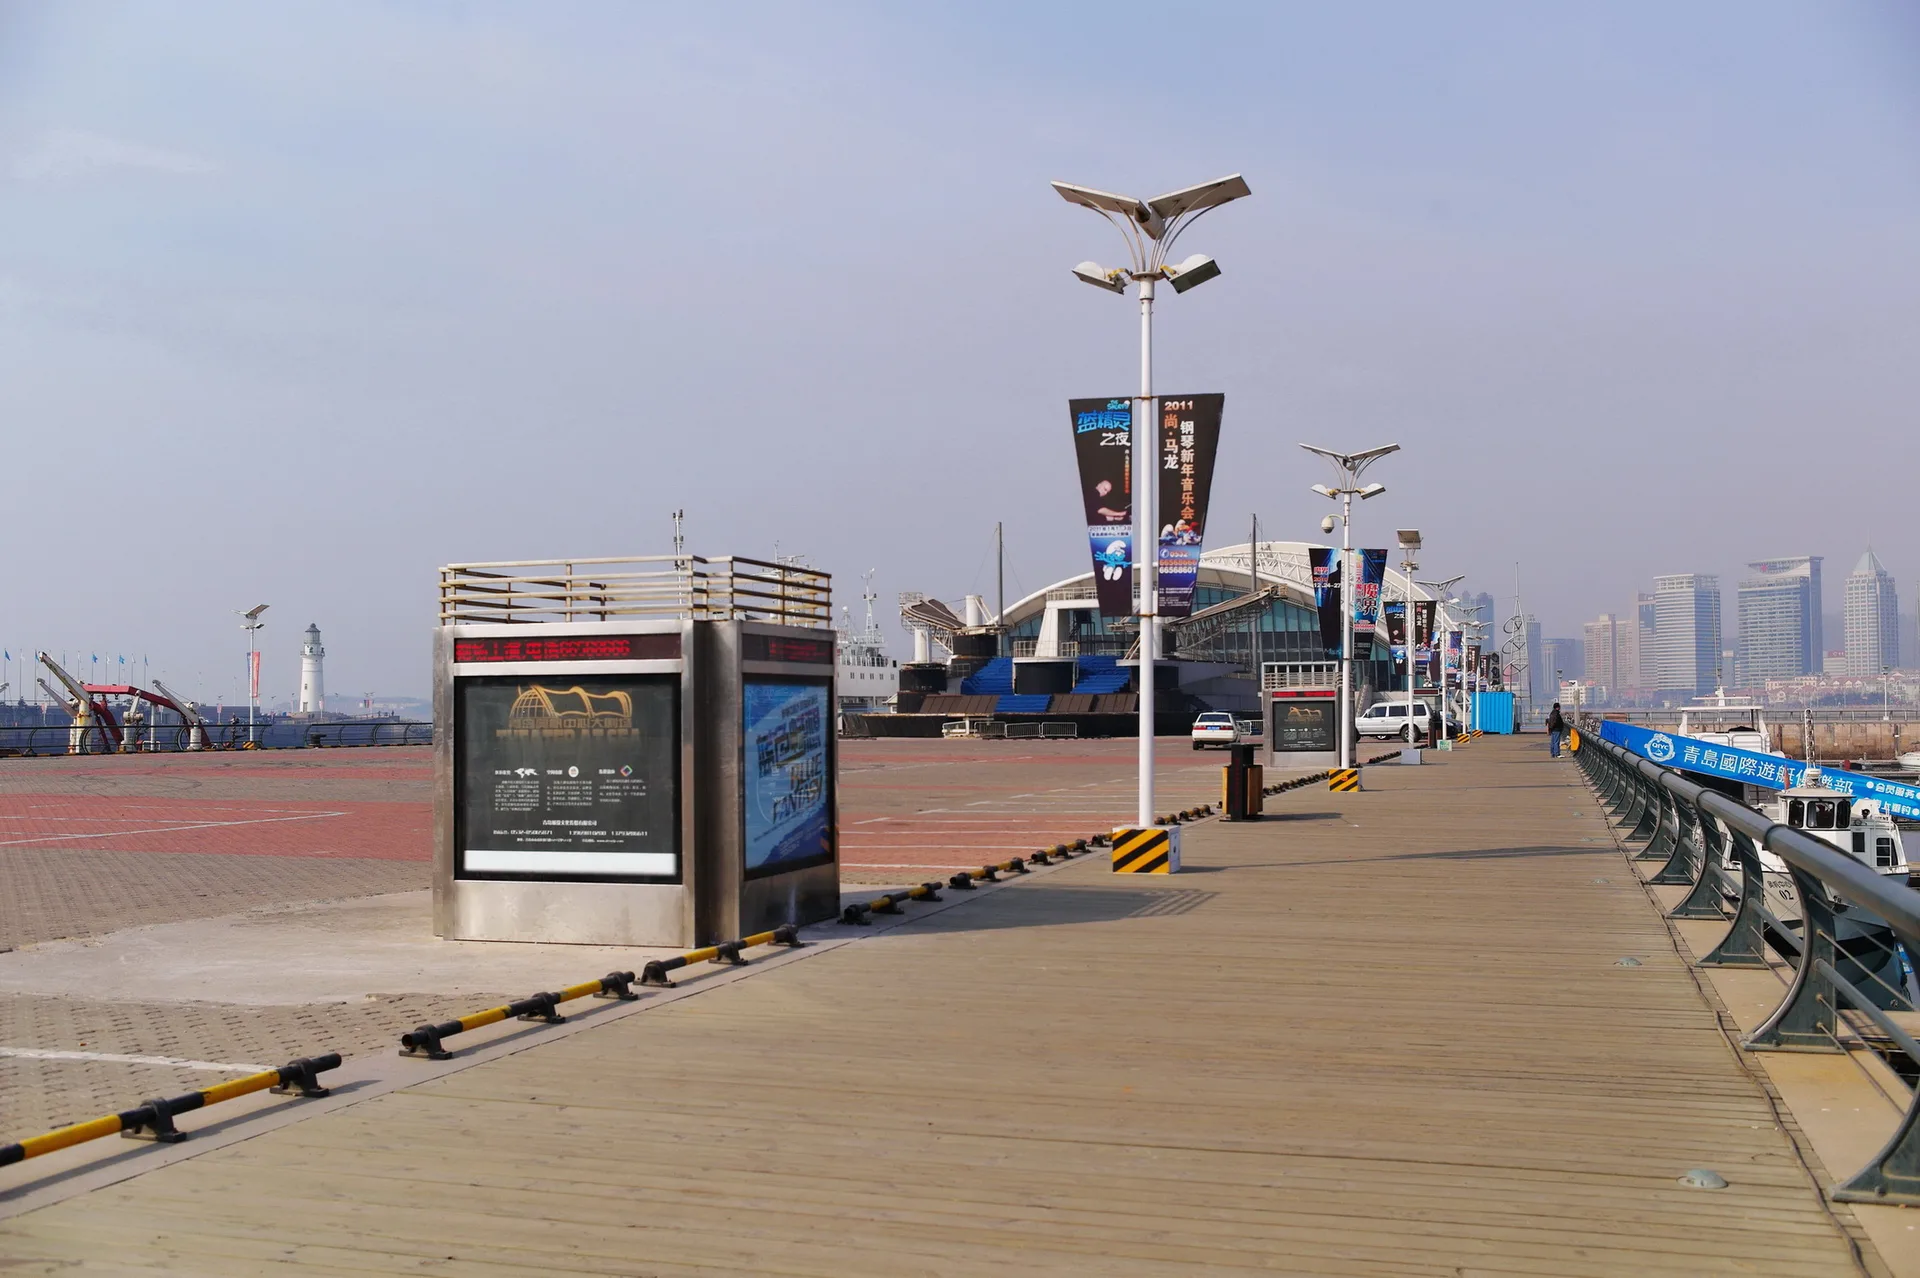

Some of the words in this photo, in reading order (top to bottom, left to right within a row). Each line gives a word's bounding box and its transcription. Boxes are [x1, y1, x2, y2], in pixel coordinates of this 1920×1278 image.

[1164, 400, 1194, 411] 2011
[1076, 410, 1131, 434] 蓝精灵
[1099, 431, 1132, 447] 之夜
[1164, 413, 1179, 470] 尚·马龙
[1180, 420, 1195, 520] 钢琴新年音乐会
[1363, 582, 1380, 617] 魔界
[1874, 781, 1915, 800] 会员服务
[1778, 889, 1795, 901] 02
